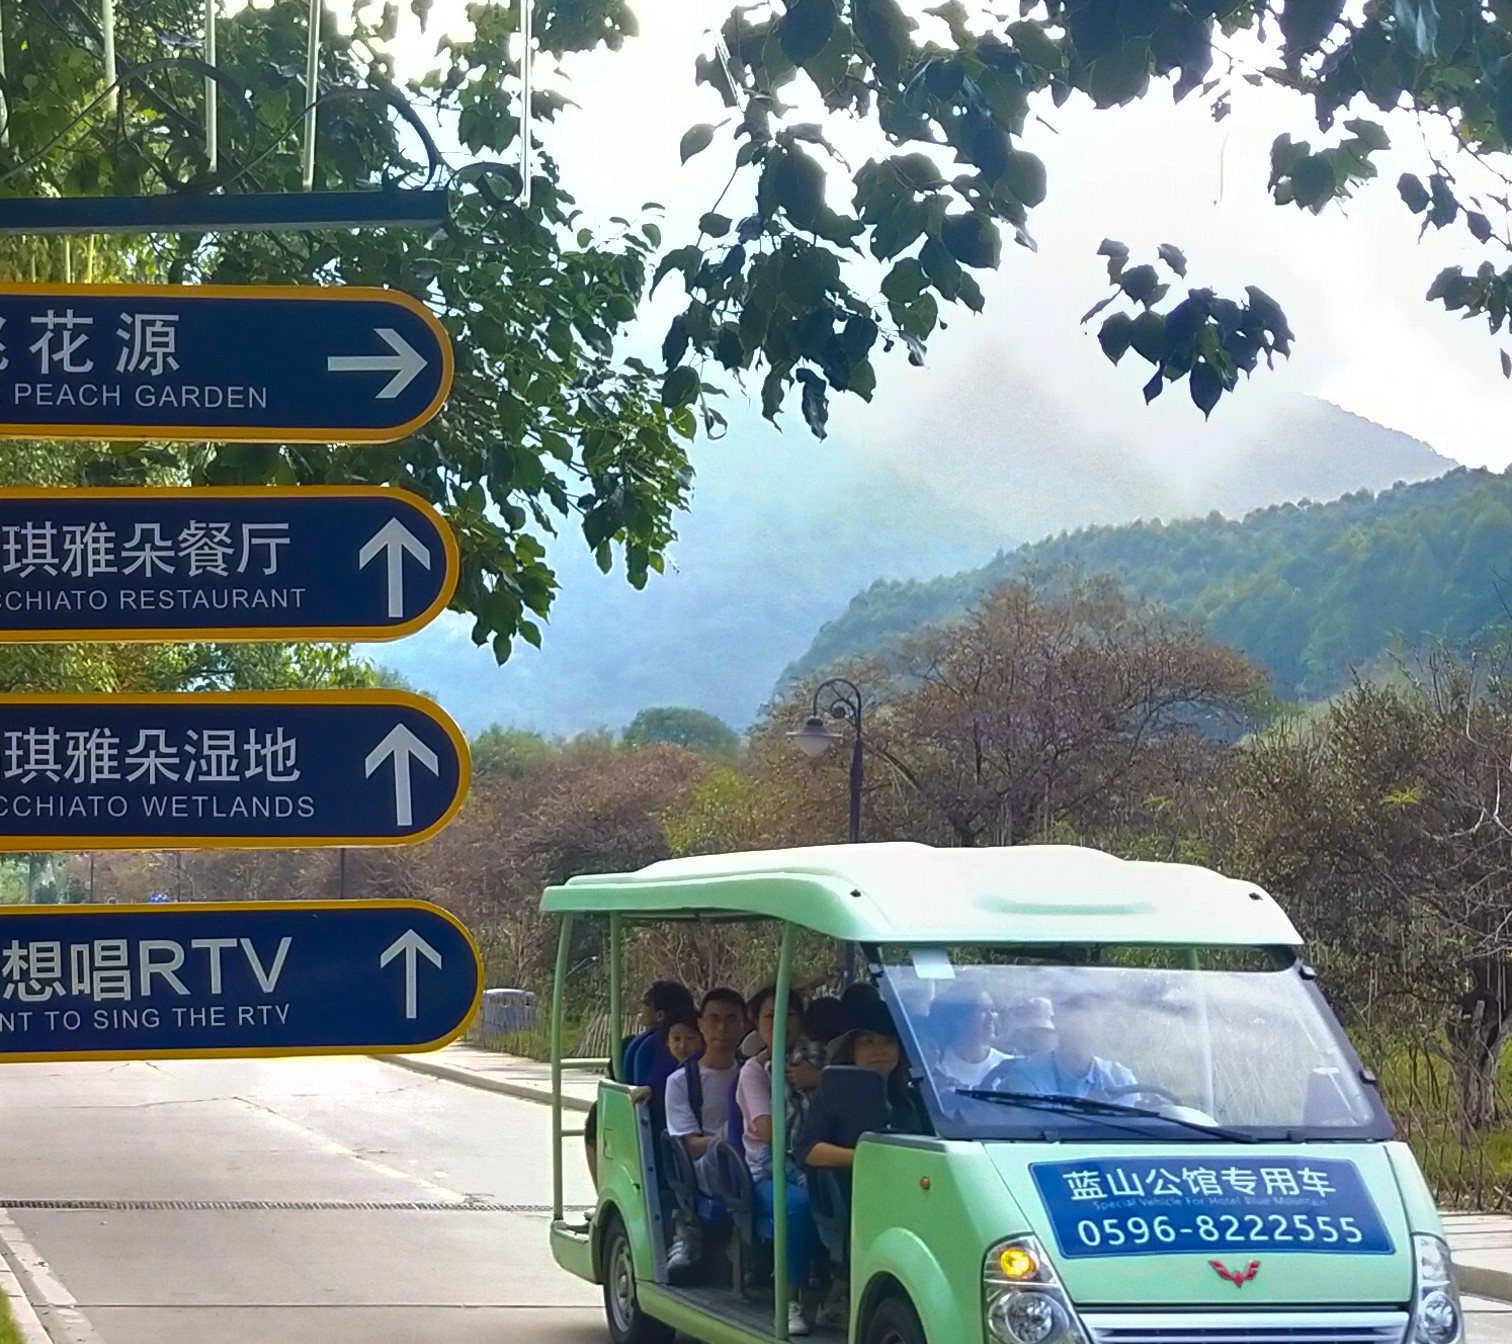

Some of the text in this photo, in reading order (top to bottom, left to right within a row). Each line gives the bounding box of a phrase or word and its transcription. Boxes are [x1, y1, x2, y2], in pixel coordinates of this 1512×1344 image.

[13, 382, 122, 408] PEACH
[133, 384, 268, 410] GARDEN
[118, 586, 307, 612] RESTAURANT
[140, 794, 317, 820] WETLANDS
[43, 1008, 83, 1032] TO
[91, 1006, 162, 1031] SING
[170, 1005, 227, 1029] THE
[236, 1002, 292, 1028] RTV
[1061, 1166, 1337, 1201] 蓝山公馆专用车
[1076, 1213, 1363, 1248] 0596-8222555
